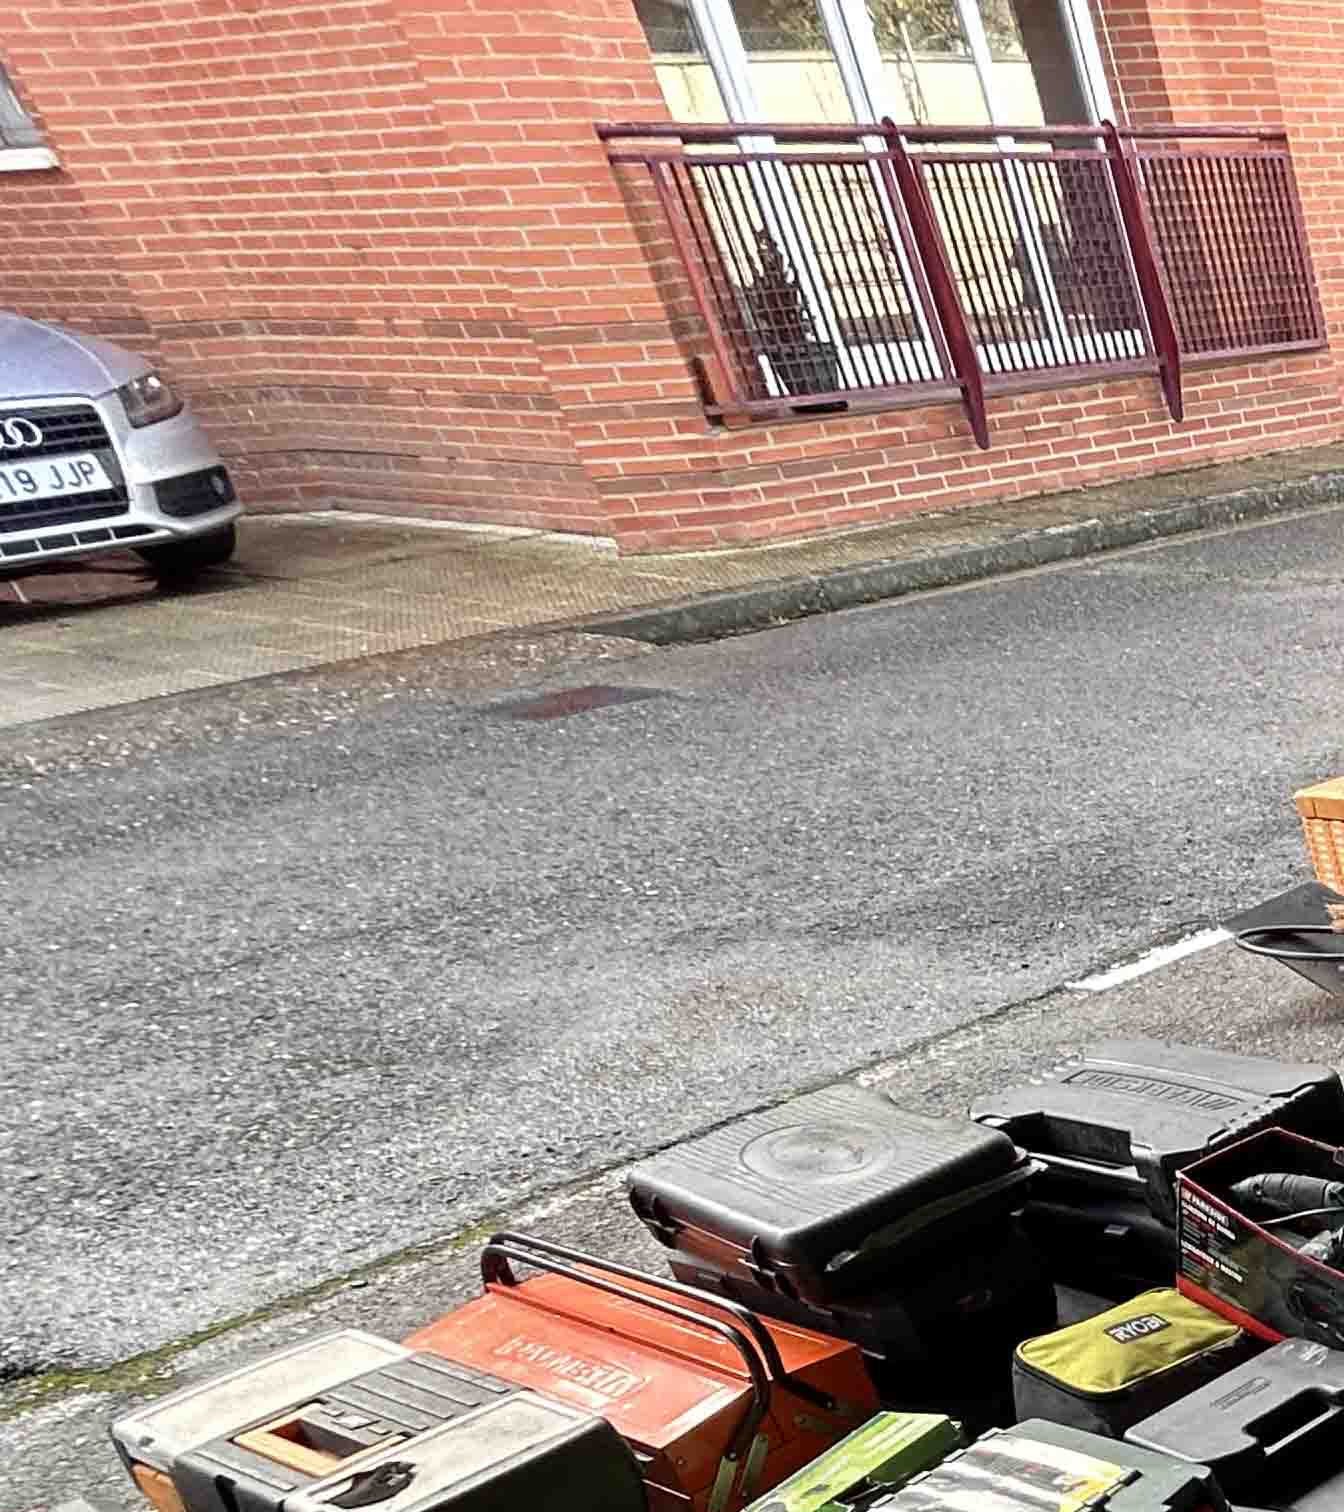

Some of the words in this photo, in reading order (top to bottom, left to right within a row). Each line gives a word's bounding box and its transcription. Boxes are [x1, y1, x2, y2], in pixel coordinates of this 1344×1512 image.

[0, 467, 39, 497] 19
[50, 460, 95, 490] JJP
[1109, 1314, 1166, 1342] RYOBI
